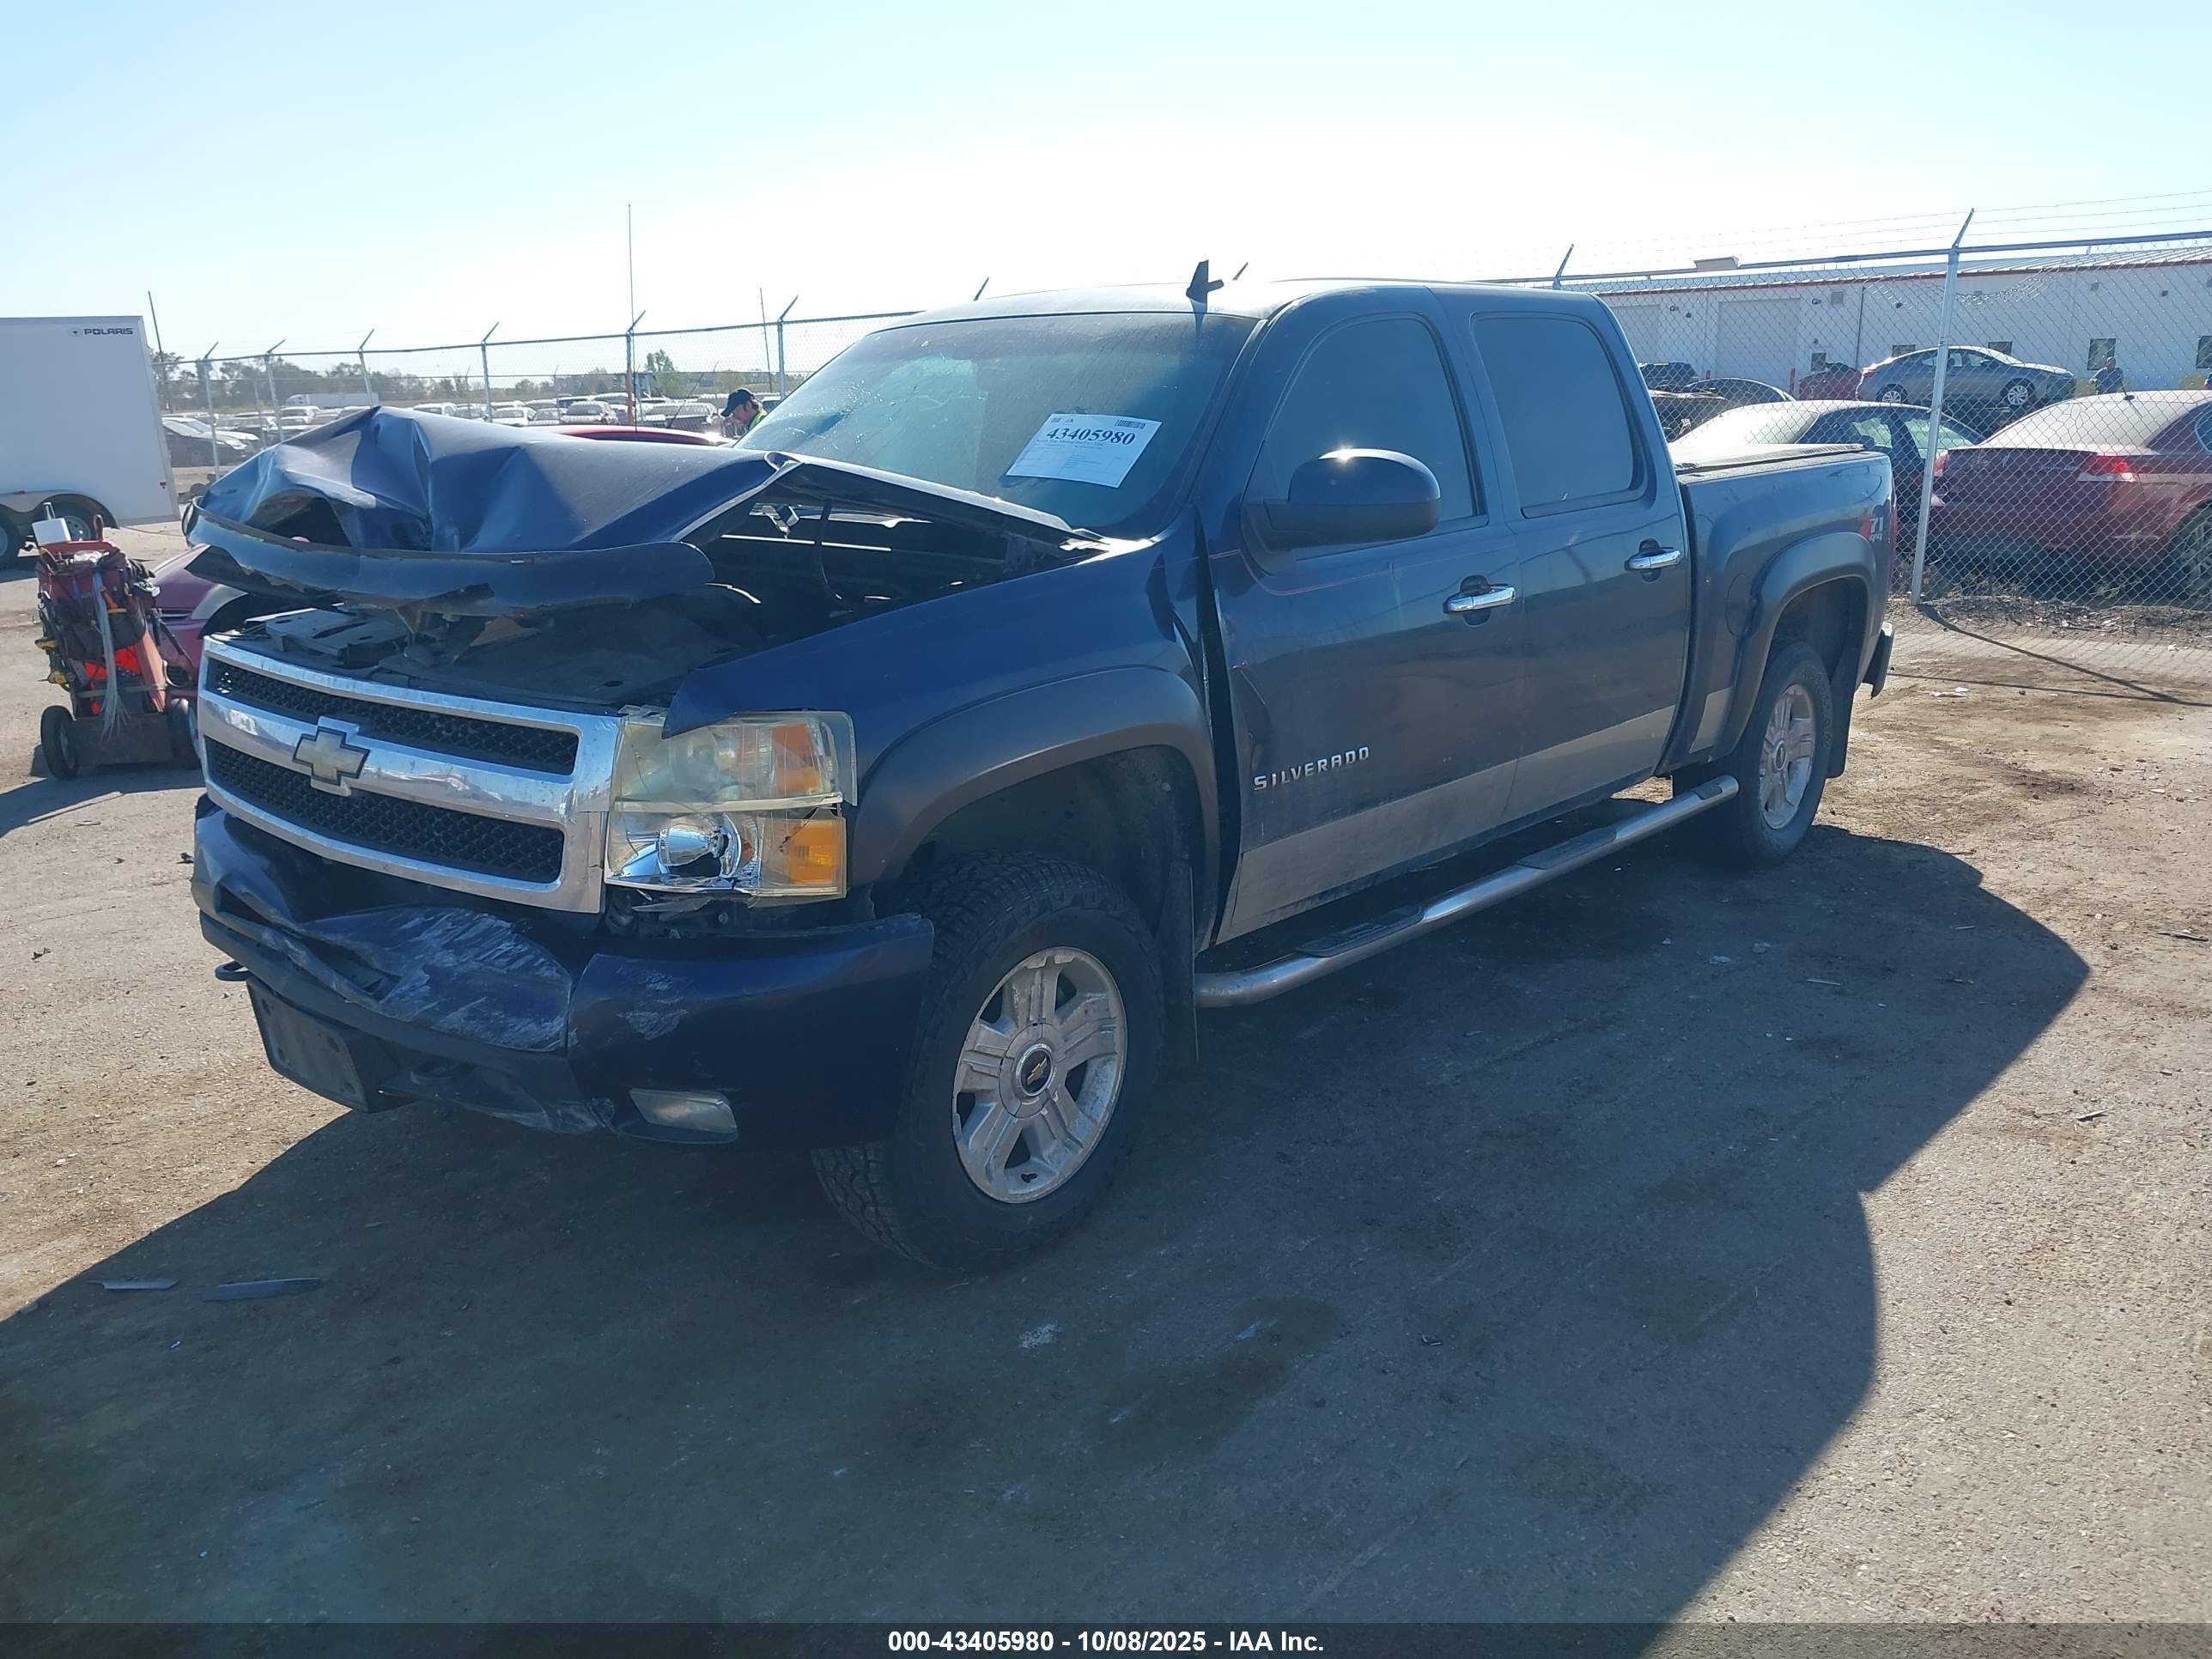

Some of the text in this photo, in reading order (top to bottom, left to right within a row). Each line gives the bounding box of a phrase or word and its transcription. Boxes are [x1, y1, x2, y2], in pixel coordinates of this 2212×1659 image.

[83, 327, 134, 336] POLARIS
[1046, 428, 1136, 446] 43405980
[1254, 746, 1370, 791] SILVERADO
